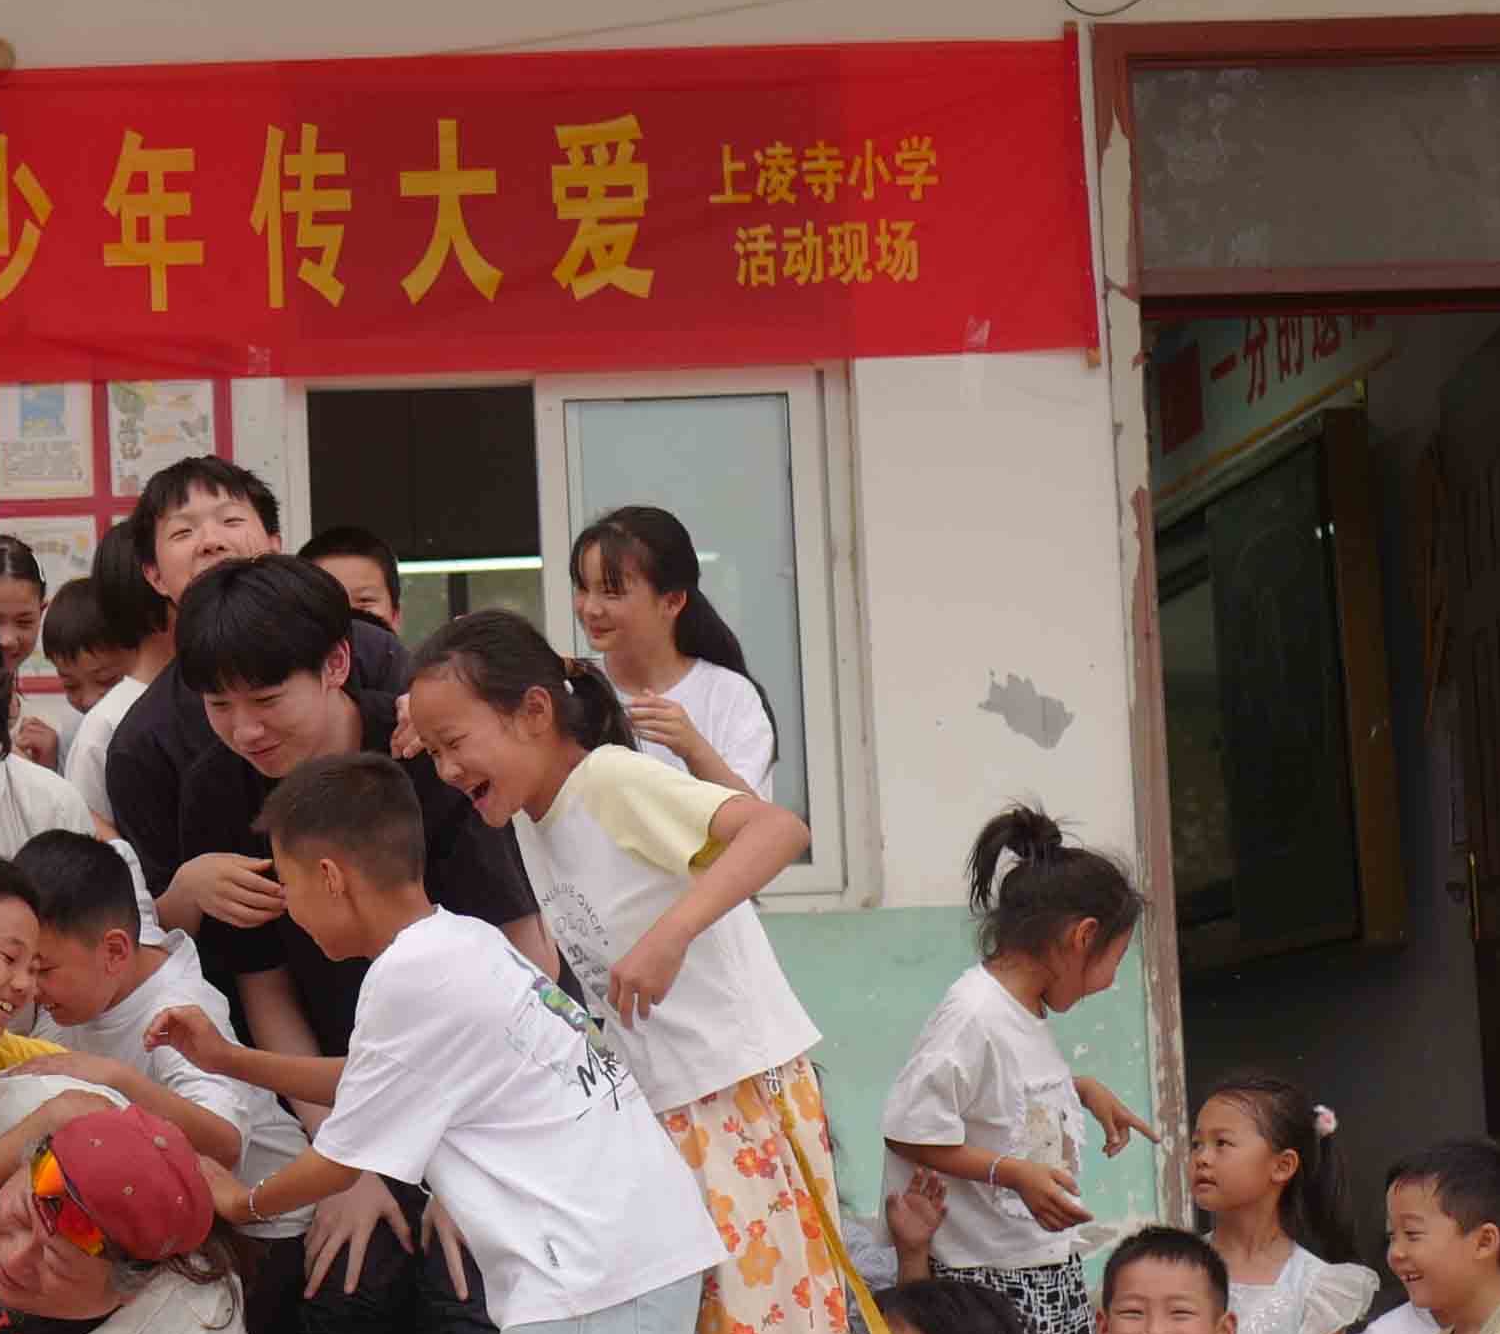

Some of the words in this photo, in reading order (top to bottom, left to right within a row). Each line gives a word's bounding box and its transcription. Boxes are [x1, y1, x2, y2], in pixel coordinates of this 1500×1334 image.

[708, 136, 939, 204] 上凌寺小学
[733, 218, 921, 286] 活动现场
